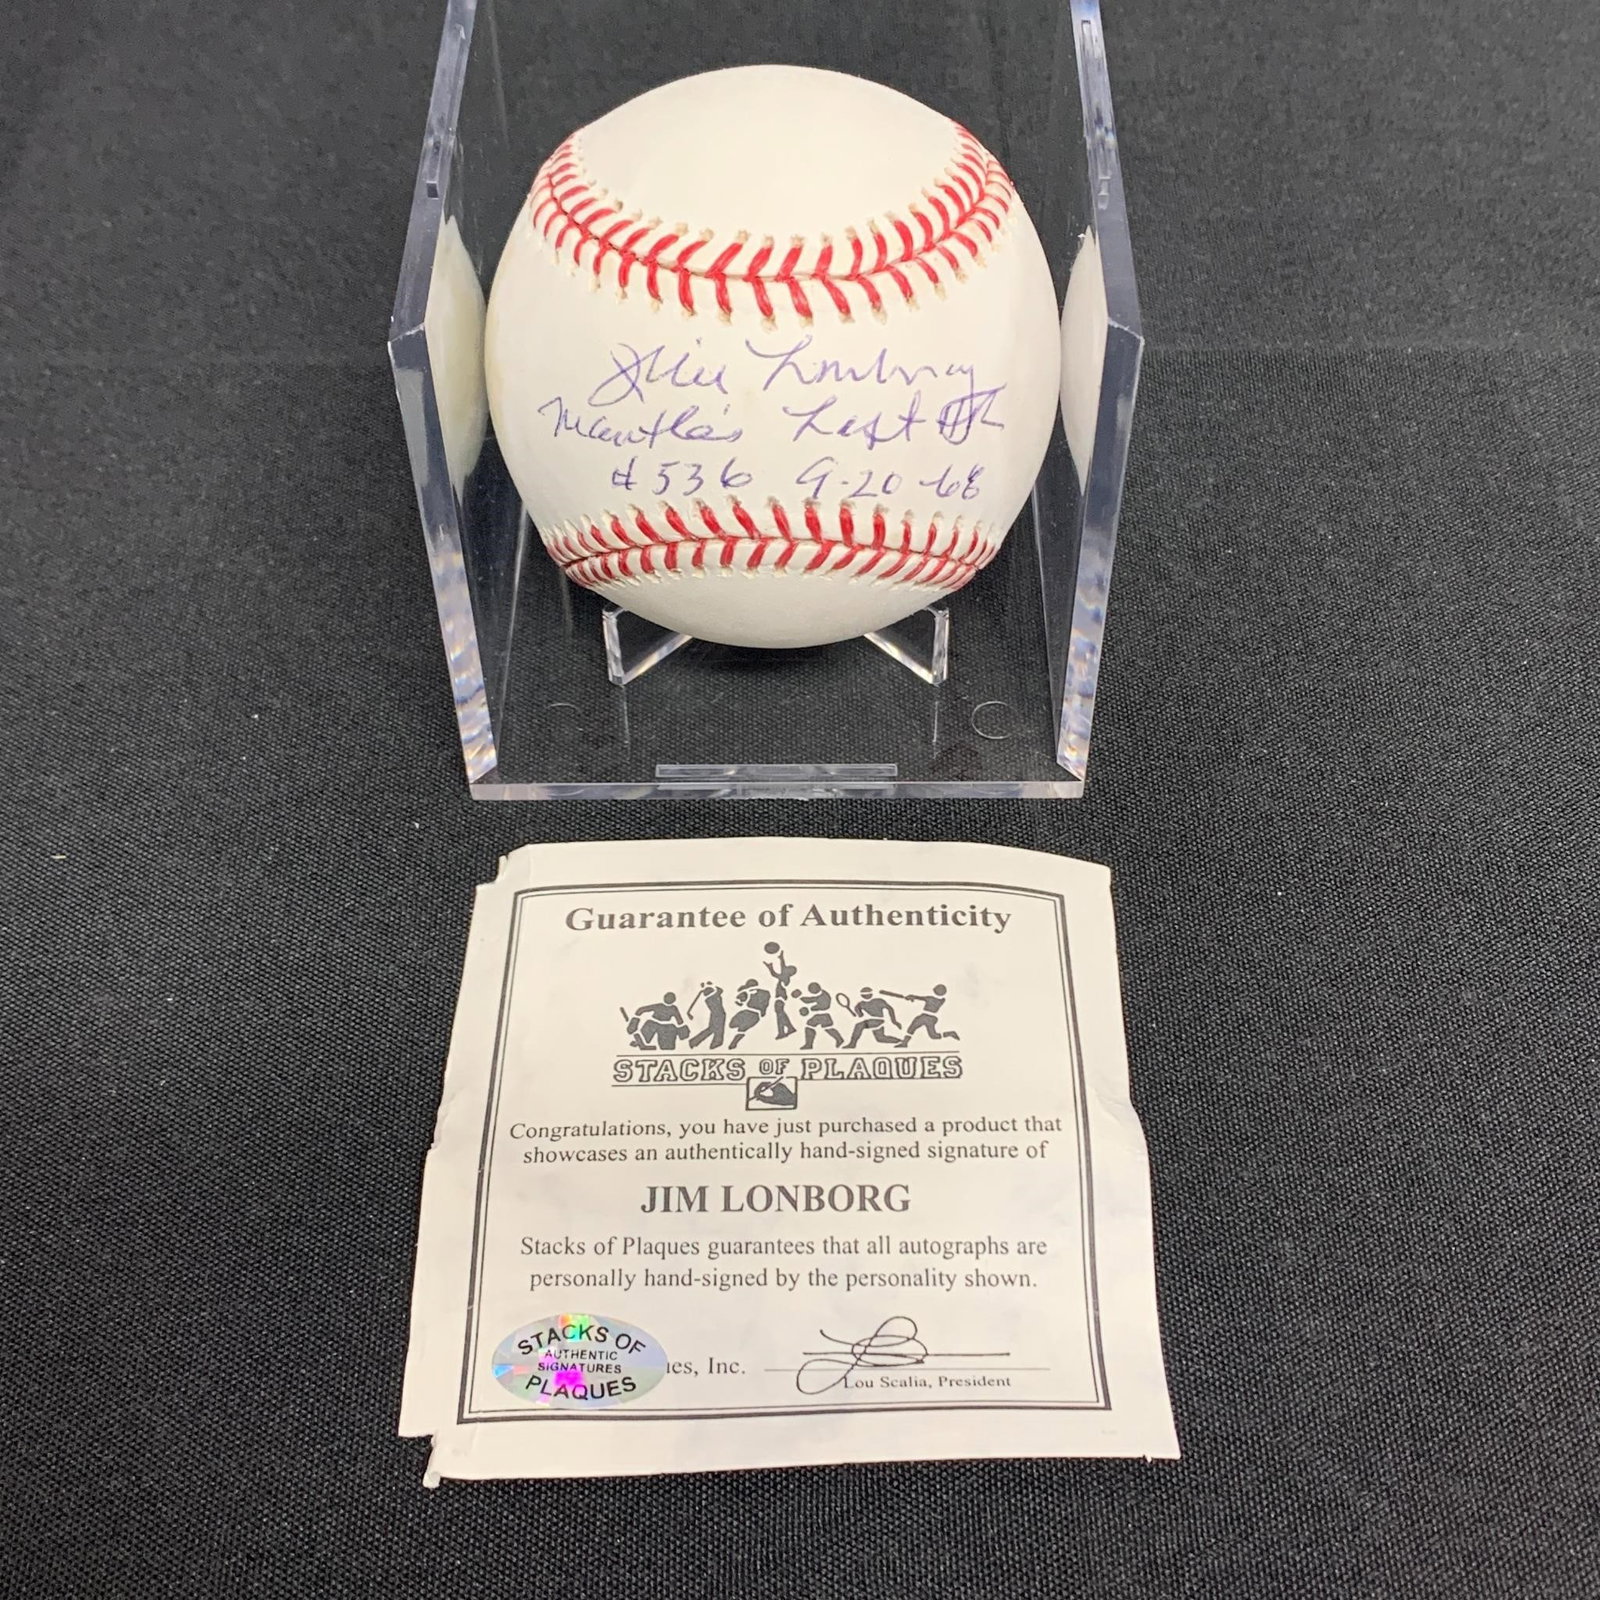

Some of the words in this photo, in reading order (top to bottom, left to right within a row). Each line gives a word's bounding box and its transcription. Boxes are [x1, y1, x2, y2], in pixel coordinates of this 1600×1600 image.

[565, 907, 746, 931] Guarantee
[758, 903, 794, 928] of
[800, 903, 1012, 934] Authenticity
[613, 1058, 746, 1083] STACKS
[759, 1058, 790, 1076] OF
[800, 1055, 963, 1081] PLAQUES
[510, 1120, 672, 1142] Congratulations,
[679, 1123, 716, 1139] you
[724, 1119, 769, 1135] have
[773, 1118, 812, 1138] just
[818, 1117, 918, 1138] purchased
[924, 1121, 936, 1133] a
[942, 1116, 1019, 1137] product
[1025, 1115, 1063, 1133] that
[523, 1146, 628, 1164] showcases
[635, 1150, 658, 1161] an
[665, 1142, 793, 1164] authentically
[800, 1141, 921, 1163] hand-signed
[927, 1141, 1020, 1163] signature
[1026, 1140, 1050, 1159] of
[640, 1185, 710, 1214] JIM
[720, 1183, 911, 1213] LONBORG
[520, 1236, 586, 1256] Stacks
[593, 1236, 618, 1256] of
[622, 1236, 701, 1261] Plaques
[707, 1238, 815, 1261] guarantees
[822, 1235, 861, 1255] that
[866, 1235, 892, 1255] all
[898, 1235, 1010, 1260] autographs
[1016, 1241, 1048, 1255] are
[530, 1269, 637, 1291] personally
[643, 1268, 768, 1292] hand-signed
[775, 1267, 801, 1291] by
[807, 1267, 839, 1287] the
[845, 1267, 958, 1292] personality
[964, 1267, 1038, 1288] shown.
[517, 1324, 610, 1356] STACKS
[614, 1332, 647, 1356] OF
[537, 1362, 622, 1374] SIGNATURES
[545, 1349, 619, 1361] AUTHENTIC
[708, 1357, 746, 1375] Inc.
[525, 1374, 637, 1401] PLAQUES
[843, 1377, 875, 1389] Lou
[880, 1375, 932, 1390] Scalia,
[937, 1376, 1012, 1388] President
